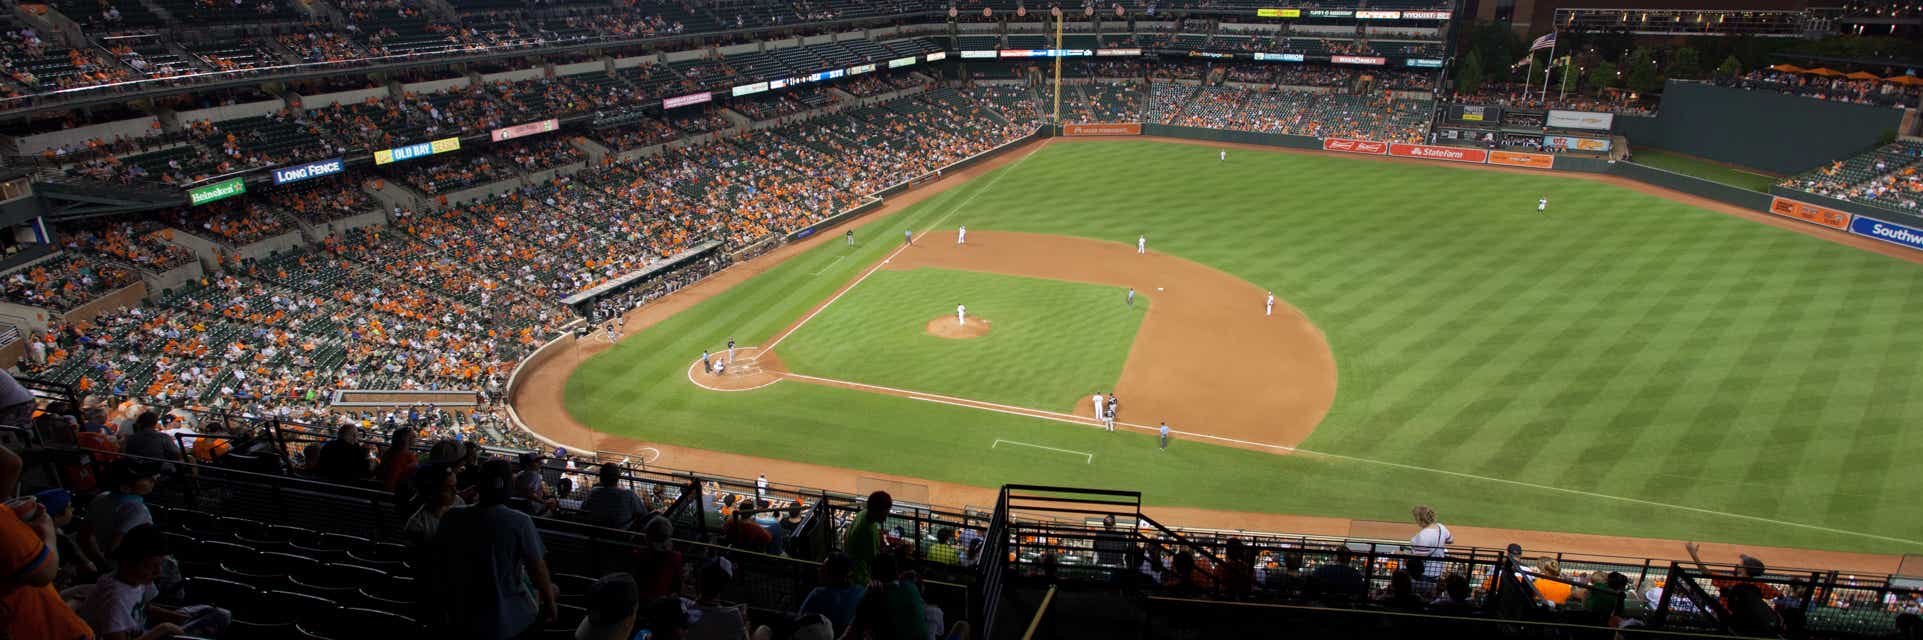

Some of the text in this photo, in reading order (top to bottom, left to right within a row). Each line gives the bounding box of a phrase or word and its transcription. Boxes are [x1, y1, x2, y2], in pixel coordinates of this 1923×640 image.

[395, 148, 412, 160] OLD
[414, 144, 430, 157] BAY
[278, 162, 340, 182] LONG FENCE
[192, 184, 233, 202] Heineken
